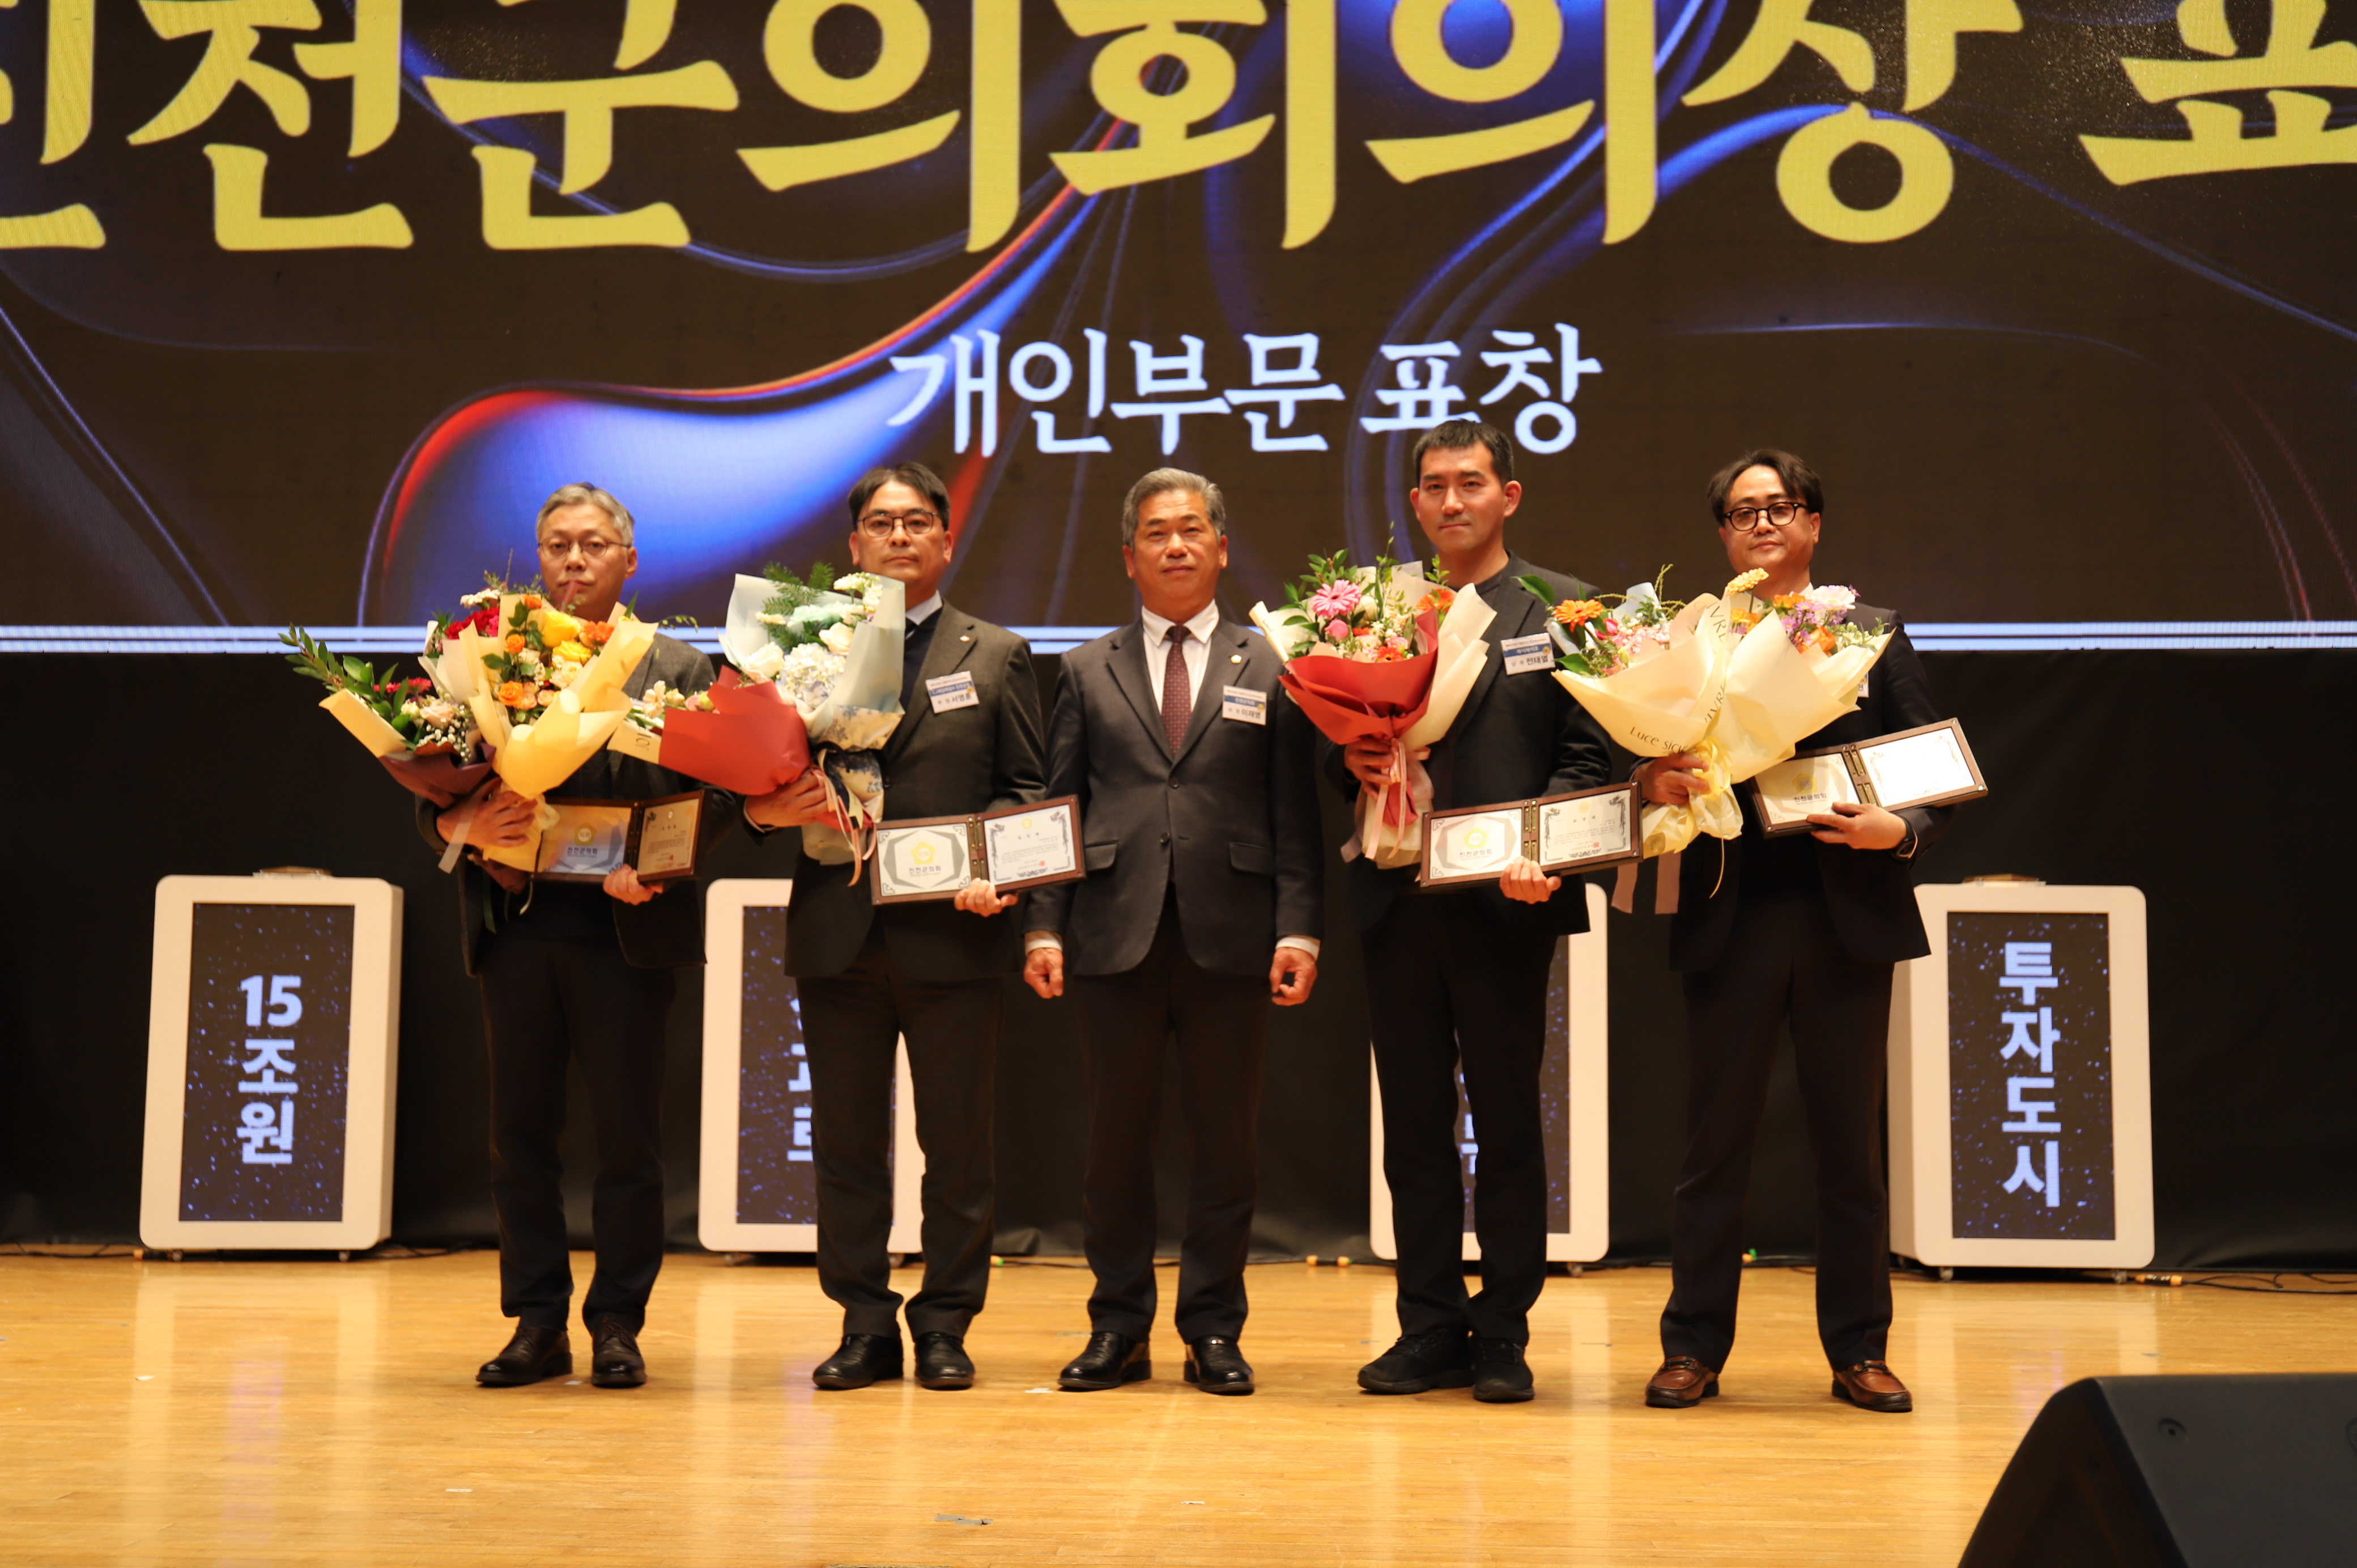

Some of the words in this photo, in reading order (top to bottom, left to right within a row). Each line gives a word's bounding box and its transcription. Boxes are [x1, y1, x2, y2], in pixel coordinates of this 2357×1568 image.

[886, 328, 1346, 458] 개인부문
[1360, 322, 1602, 454] 표창
[1630, 726, 1660, 745] Luce
[1999, 941, 2061, 1208] 투자도시
